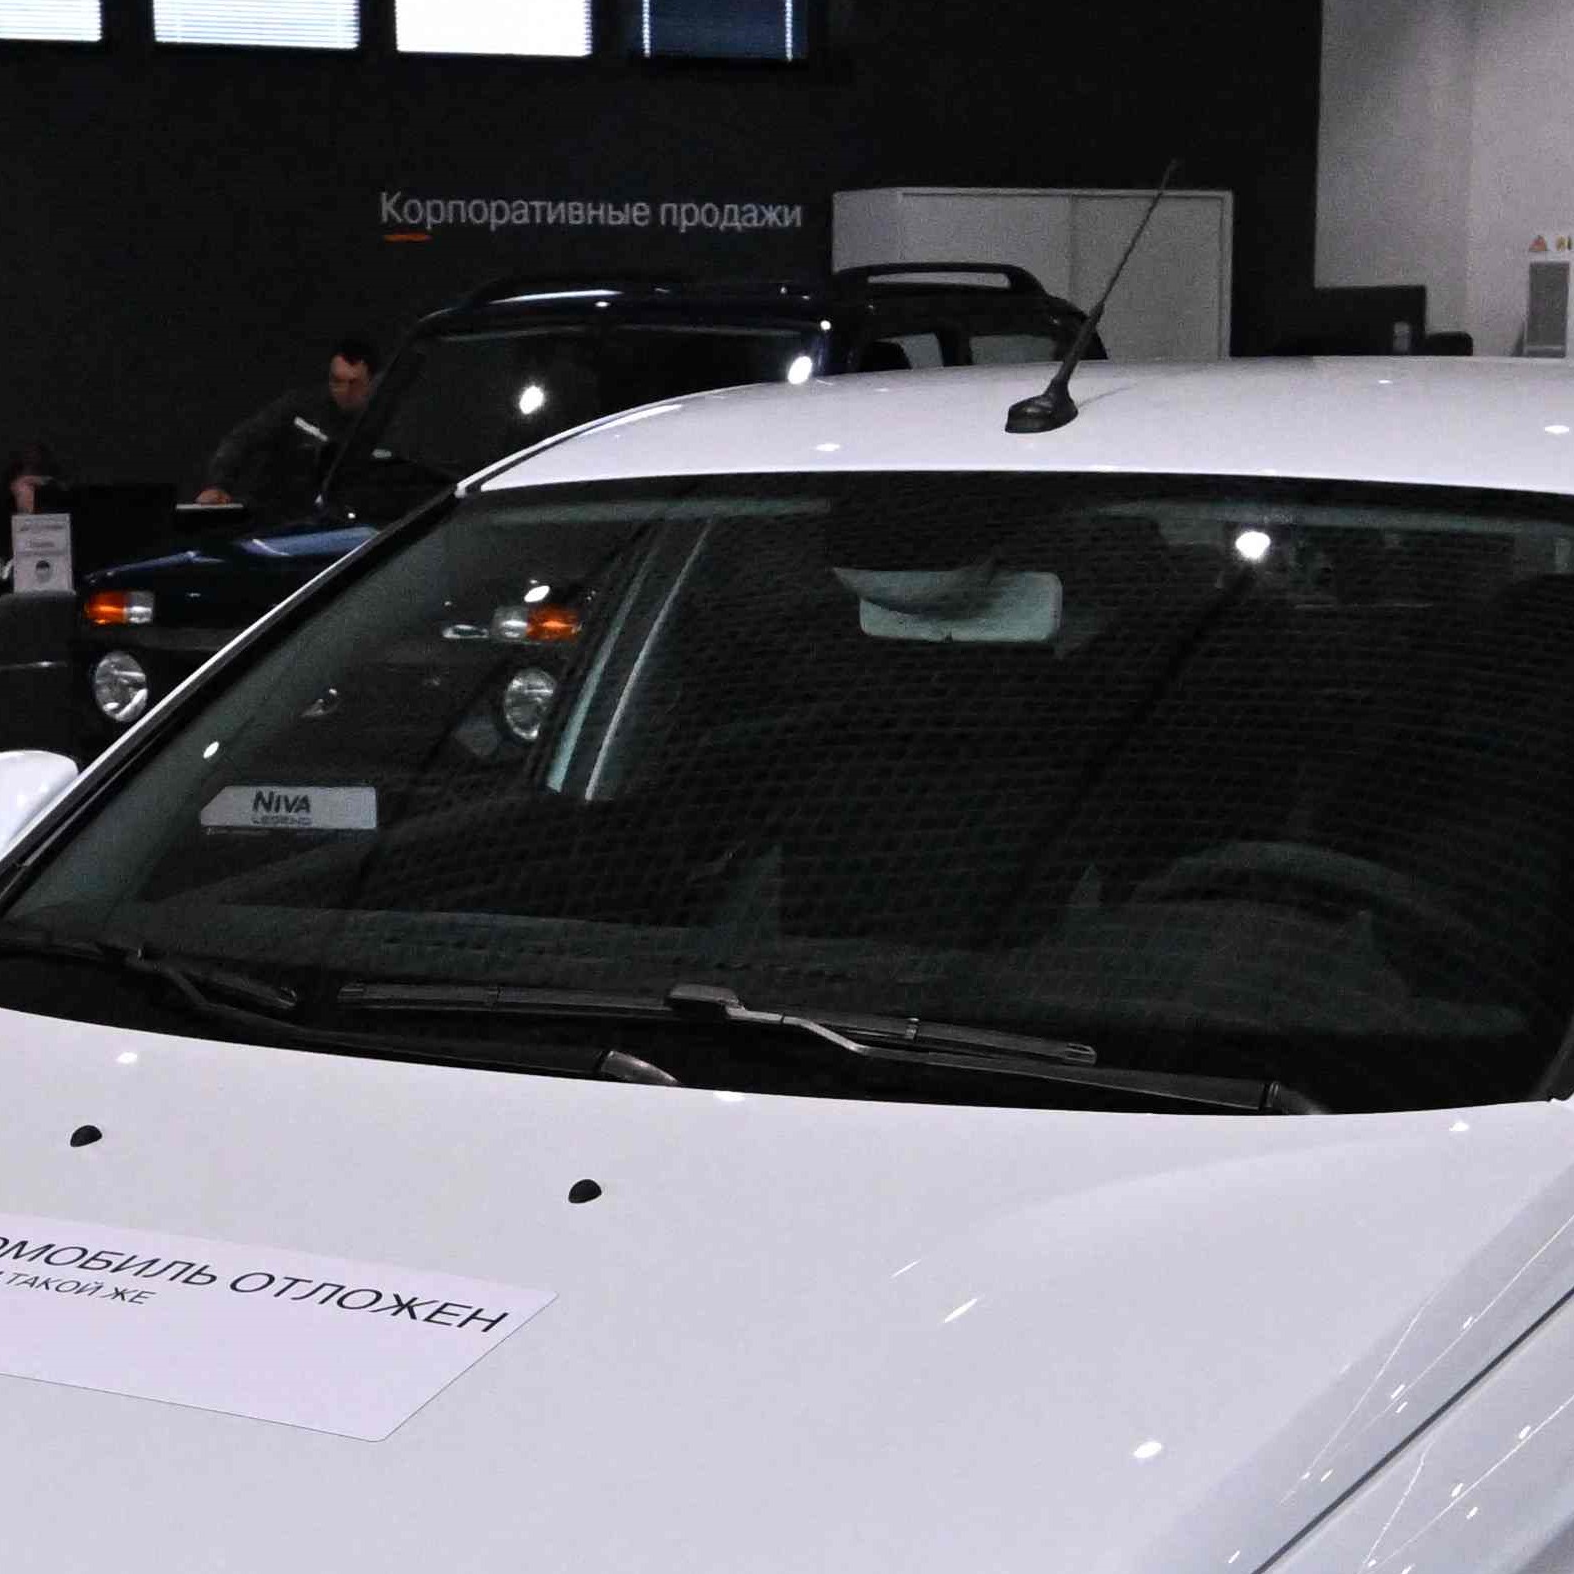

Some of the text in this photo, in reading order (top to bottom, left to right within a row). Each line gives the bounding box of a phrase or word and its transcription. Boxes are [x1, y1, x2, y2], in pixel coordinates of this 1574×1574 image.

[379, 191, 802, 232] Корпоративные продажи
[5, 1272, 104, 1298] ТАКОЙ
[101, 1289, 156, 1306] ЖЕ
[230, 1272, 510, 1333] ОТЛОЖЕН
